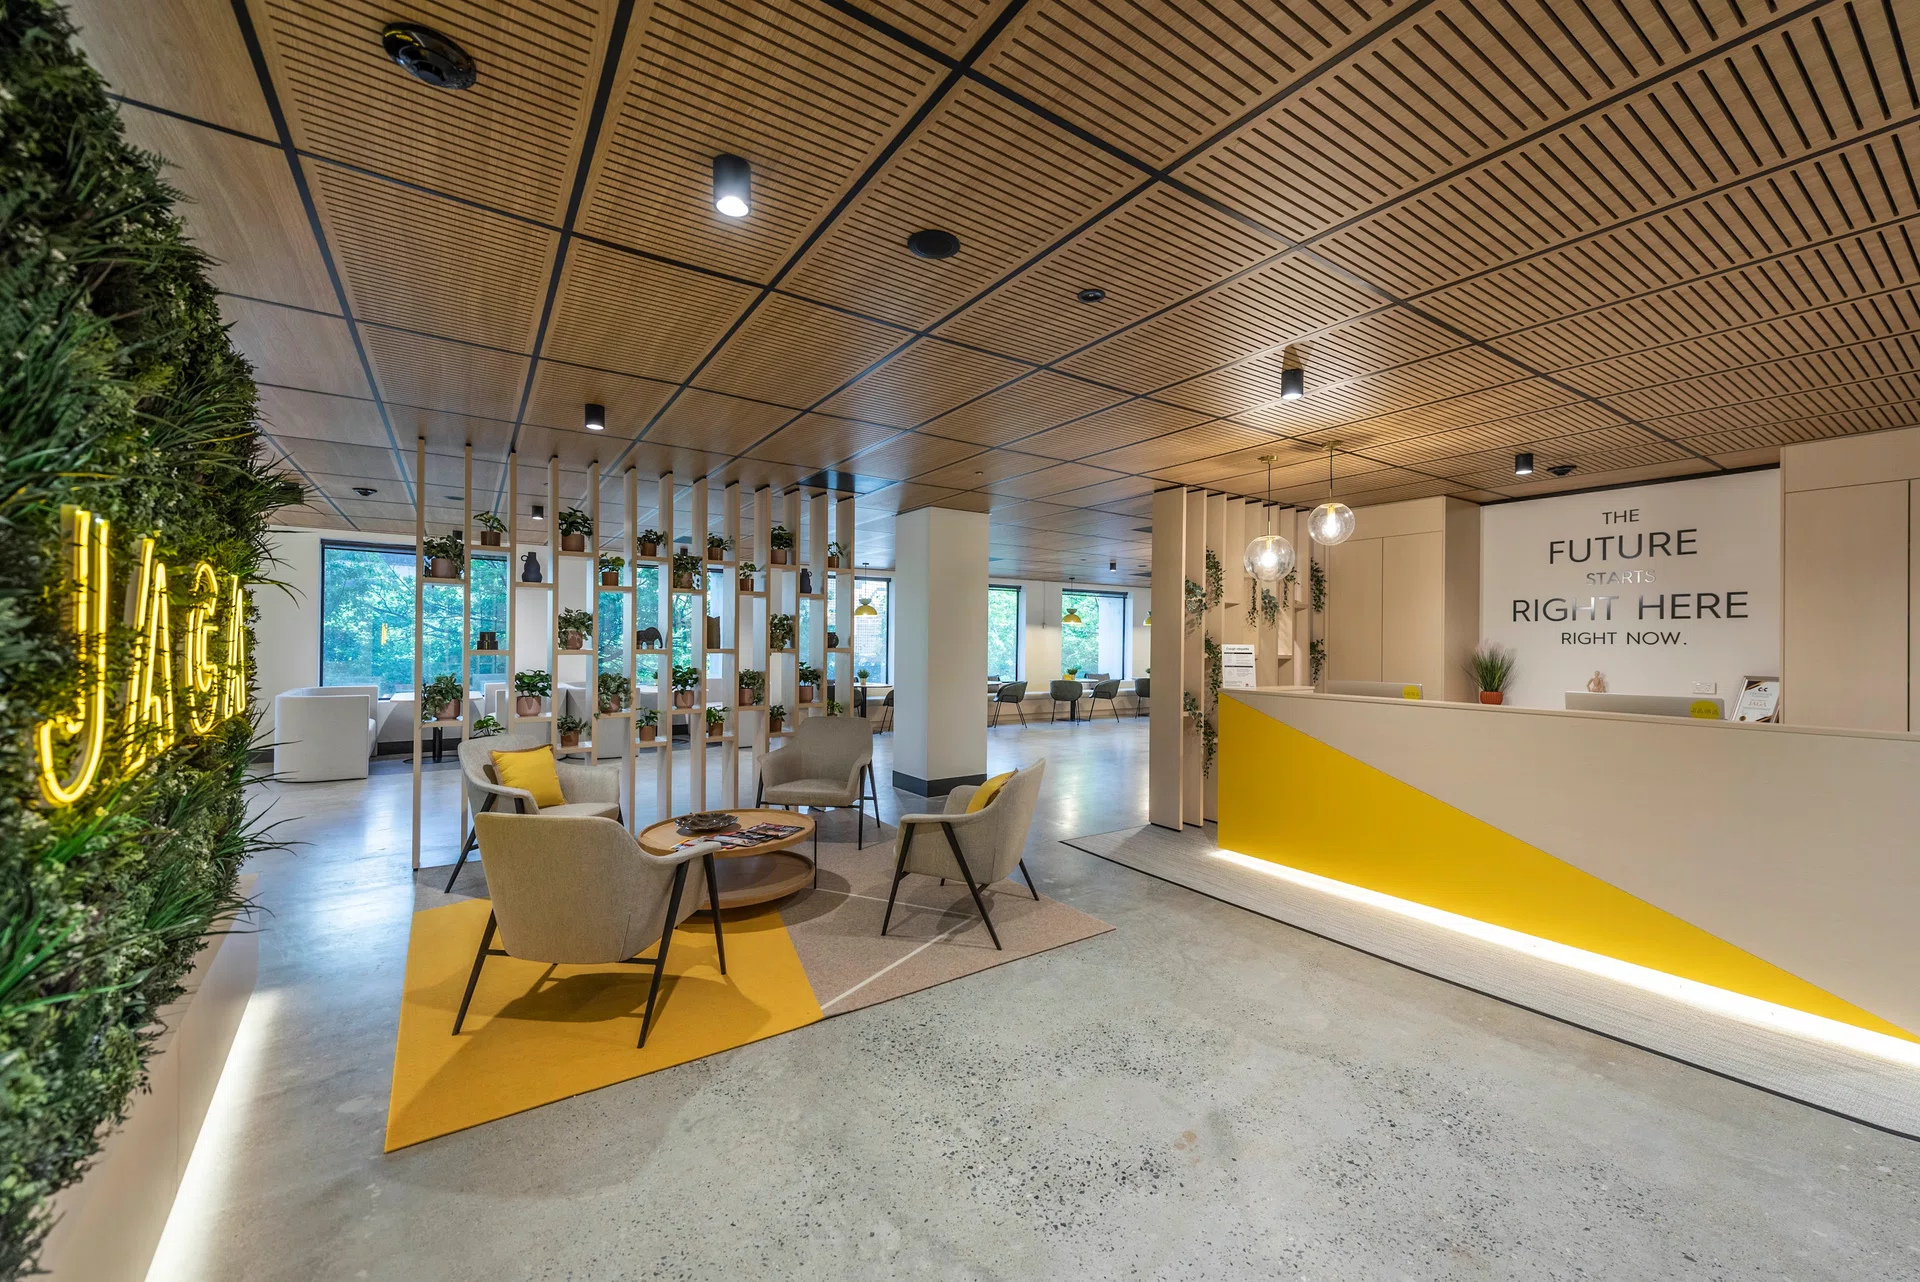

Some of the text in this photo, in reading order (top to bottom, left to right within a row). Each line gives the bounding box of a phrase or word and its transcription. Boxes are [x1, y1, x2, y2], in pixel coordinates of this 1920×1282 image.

[1602, 508, 1640, 524] THE
[1549, 528, 1698, 564] FUTURE
[1586, 569, 1656, 586] STARTS
[1512, 591, 1749, 622] RIGHT HERE
[1561, 631, 1687, 645] RIGHT NOW.
[34, 505, 247, 806] JAGA
